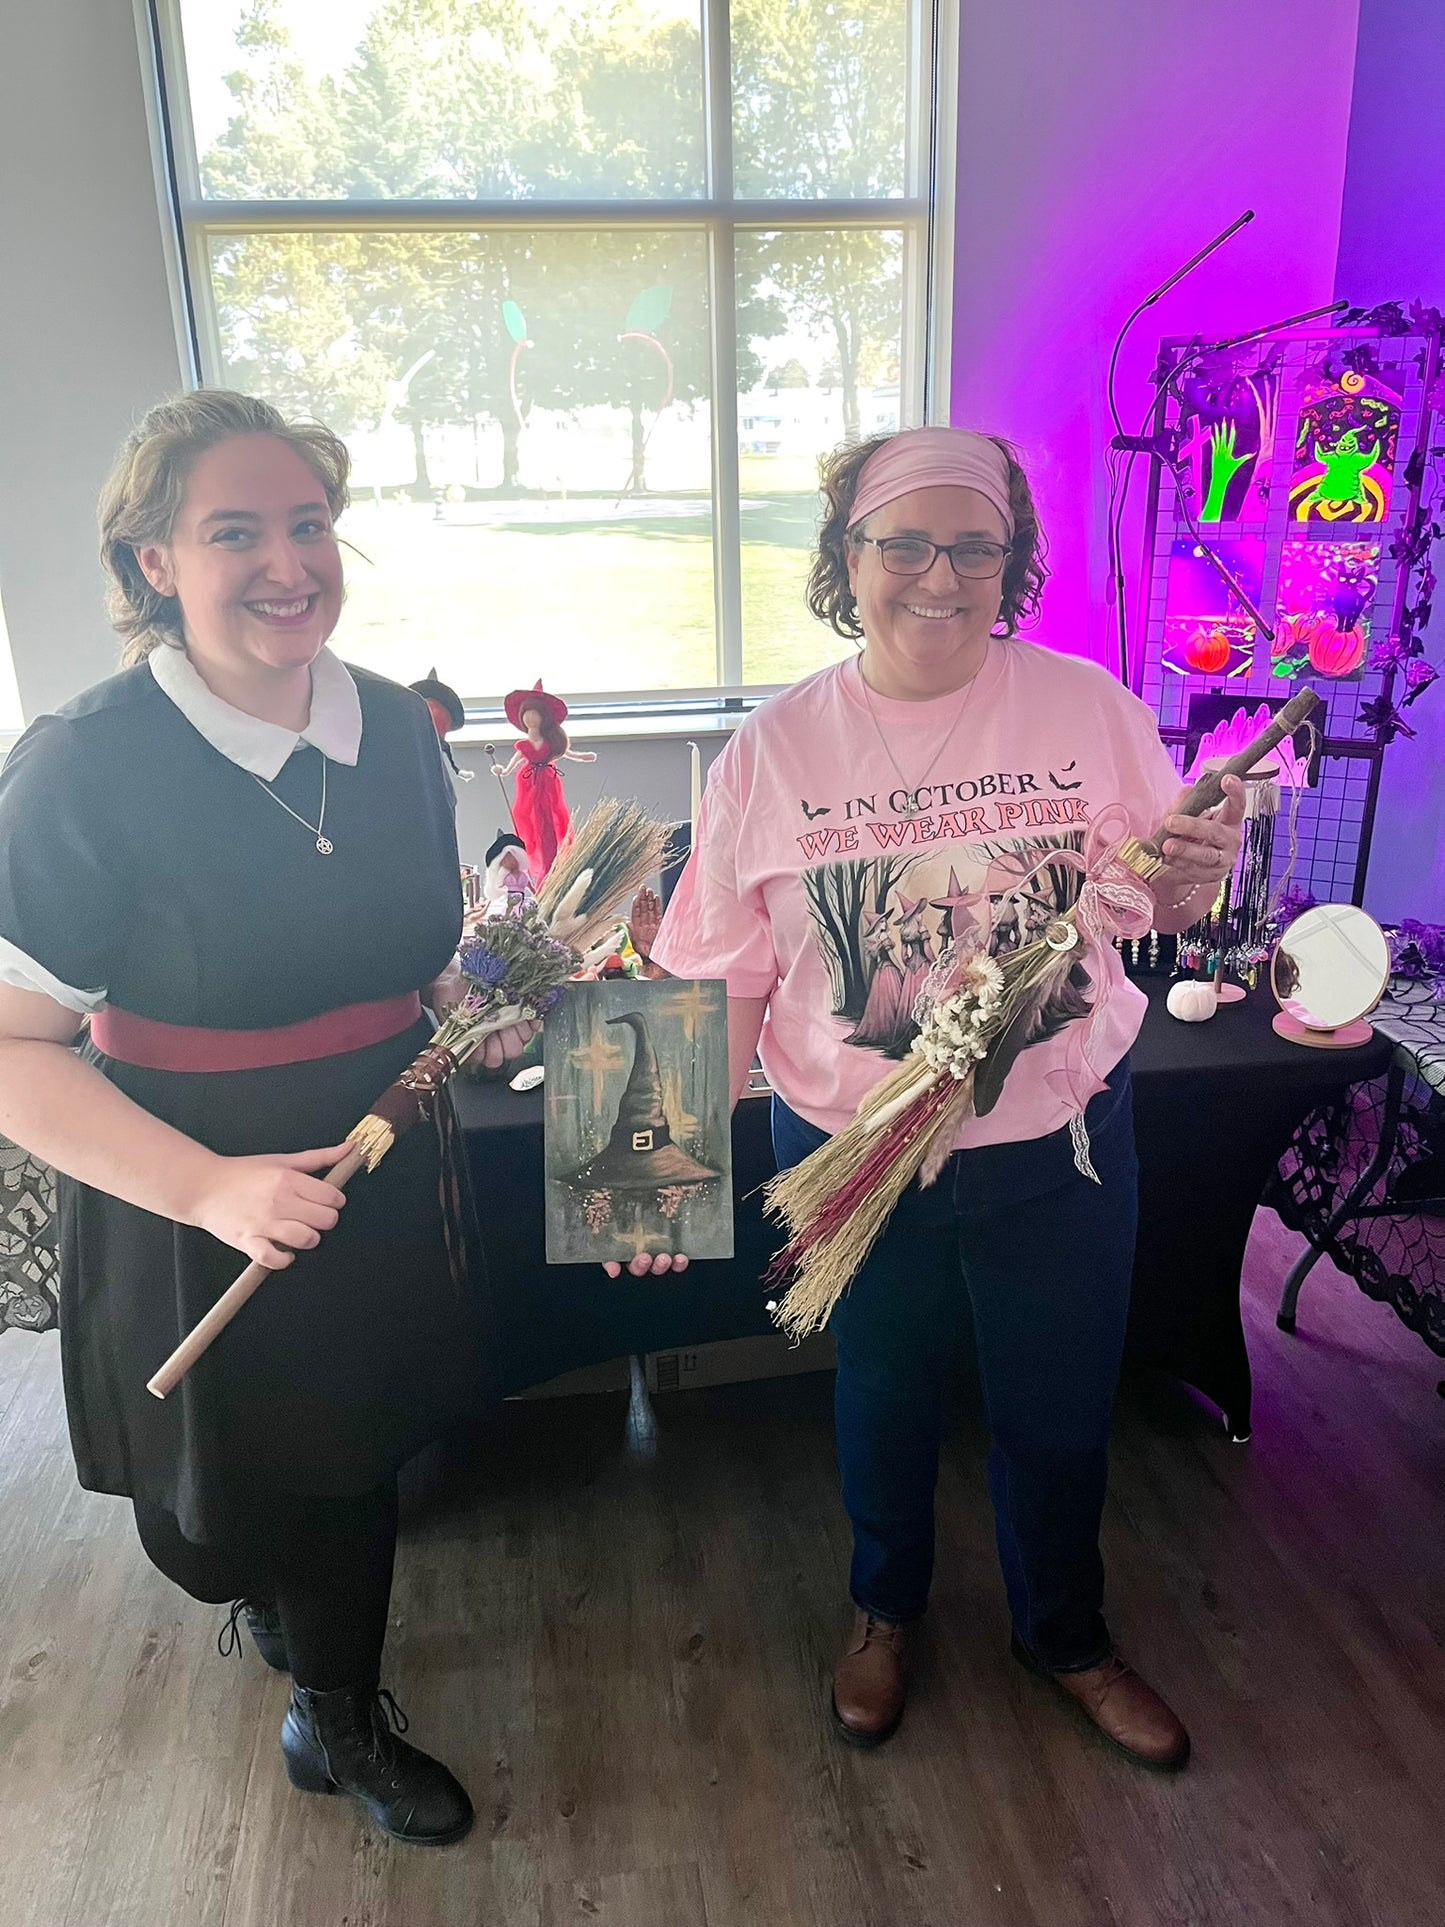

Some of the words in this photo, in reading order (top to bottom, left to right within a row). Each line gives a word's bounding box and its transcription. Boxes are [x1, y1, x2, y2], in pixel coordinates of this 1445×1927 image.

[844, 794, 877, 820] IN
[889, 773, 1042, 813] OCTOBER
[797, 826, 858, 860] WE
[866, 806, 995, 848] WEAR
[994, 798, 1092, 829] PINK
